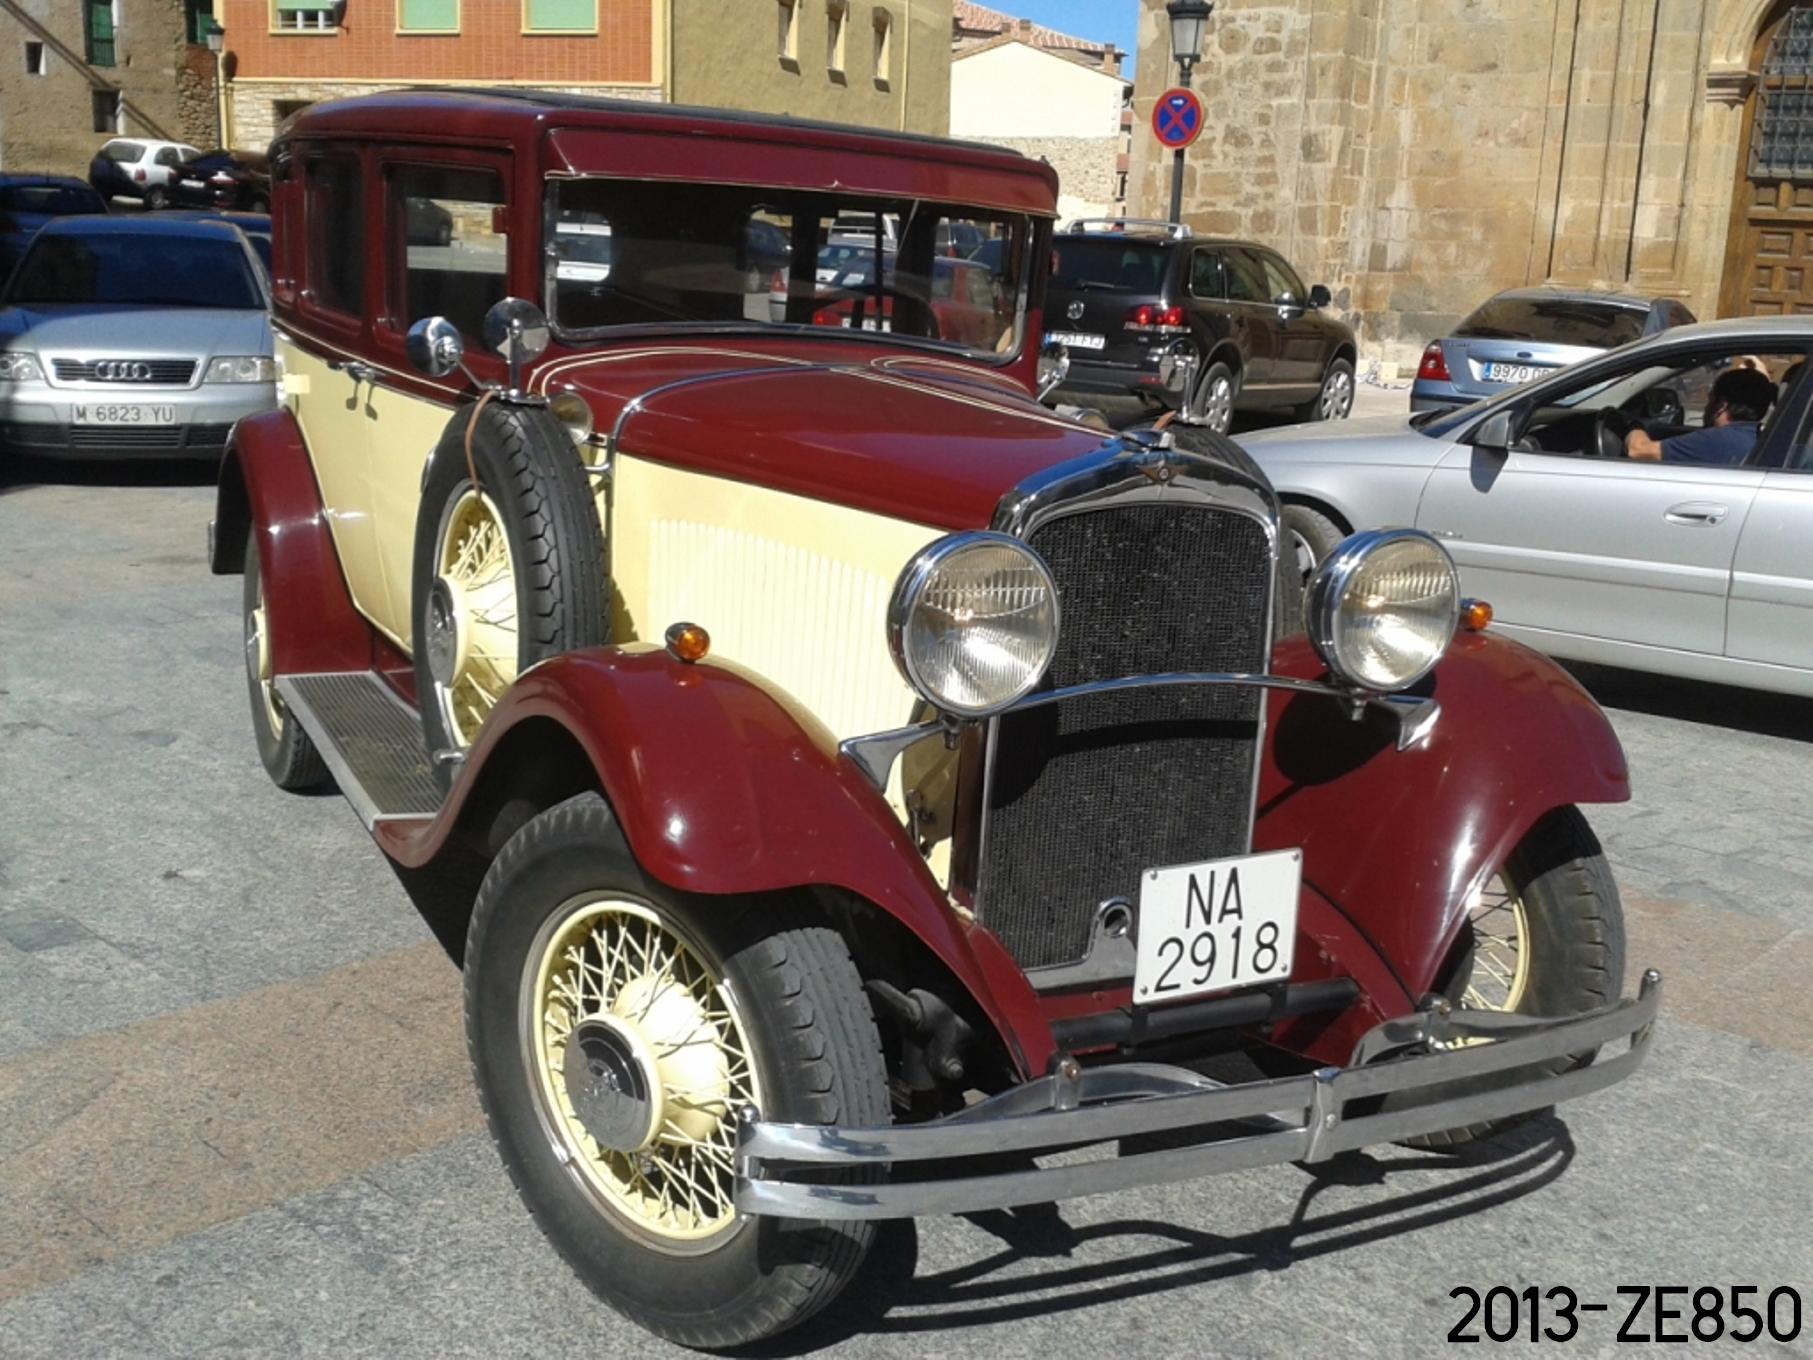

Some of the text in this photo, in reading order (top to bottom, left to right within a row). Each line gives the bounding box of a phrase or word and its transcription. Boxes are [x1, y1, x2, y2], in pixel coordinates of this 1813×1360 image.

[1493, 363, 1528, 379] 9970
[75, 405, 173, 422] M 6823 YU
[1185, 867, 1243, 929] NA
[1154, 921, 1279, 993] 2918
